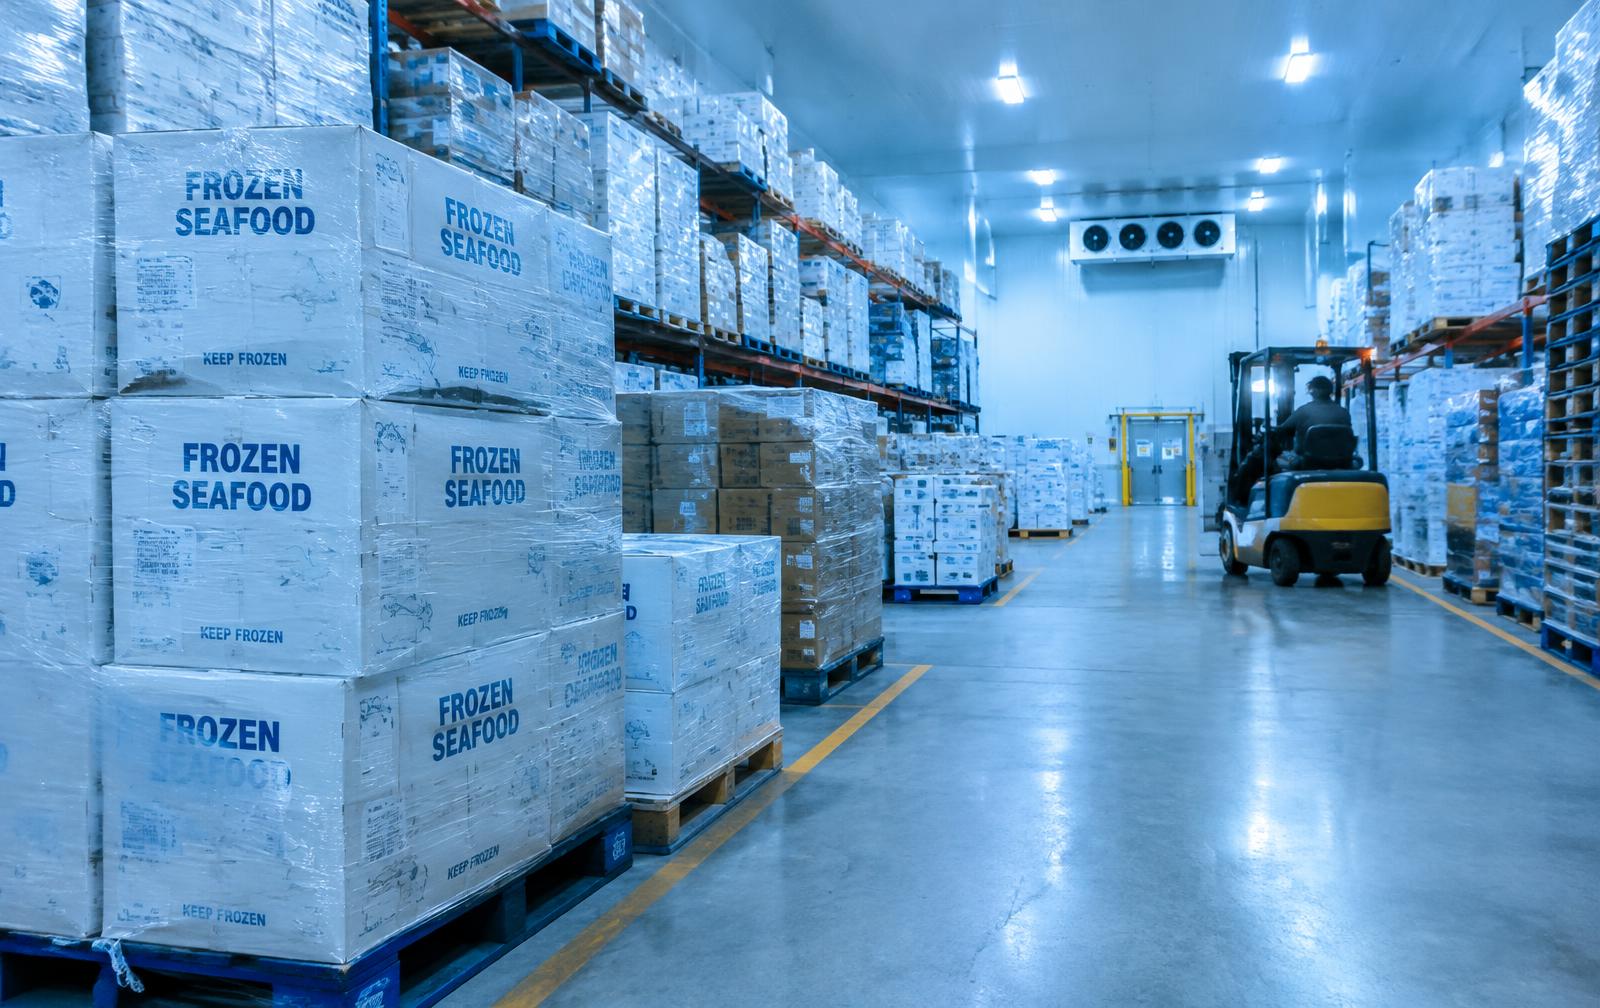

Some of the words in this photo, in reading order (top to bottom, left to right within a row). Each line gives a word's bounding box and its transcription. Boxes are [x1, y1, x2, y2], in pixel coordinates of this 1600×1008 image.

[186, 169, 303, 200] FROZEN
[175, 206, 315, 236] SEAFOOD
[445, 196, 515, 247] FROZEN
[440, 228, 522, 276] SEAFOOD
[203, 352, 234, 365] KEEP
[238, 352, 287, 366] FROZEN
[458, 365, 479, 379] KEEP
[183, 442, 300, 474] FROZEN
[451, 445, 520, 474] FROZEN
[172, 480, 311, 512] SEAFOOD
[445, 478, 526, 508] SEAFOOD
[200, 626, 231, 640] KEEP
[235, 628, 283, 643] FROZEN
[457, 611, 479, 628] KEEP
[439, 677, 513, 727] FROZEN
[160, 712, 280, 752] FROZEN
[432, 708, 520, 762] SEAFOOD
[182, 903, 213, 919] KEEP
[217, 908, 266, 927] FROZEN
